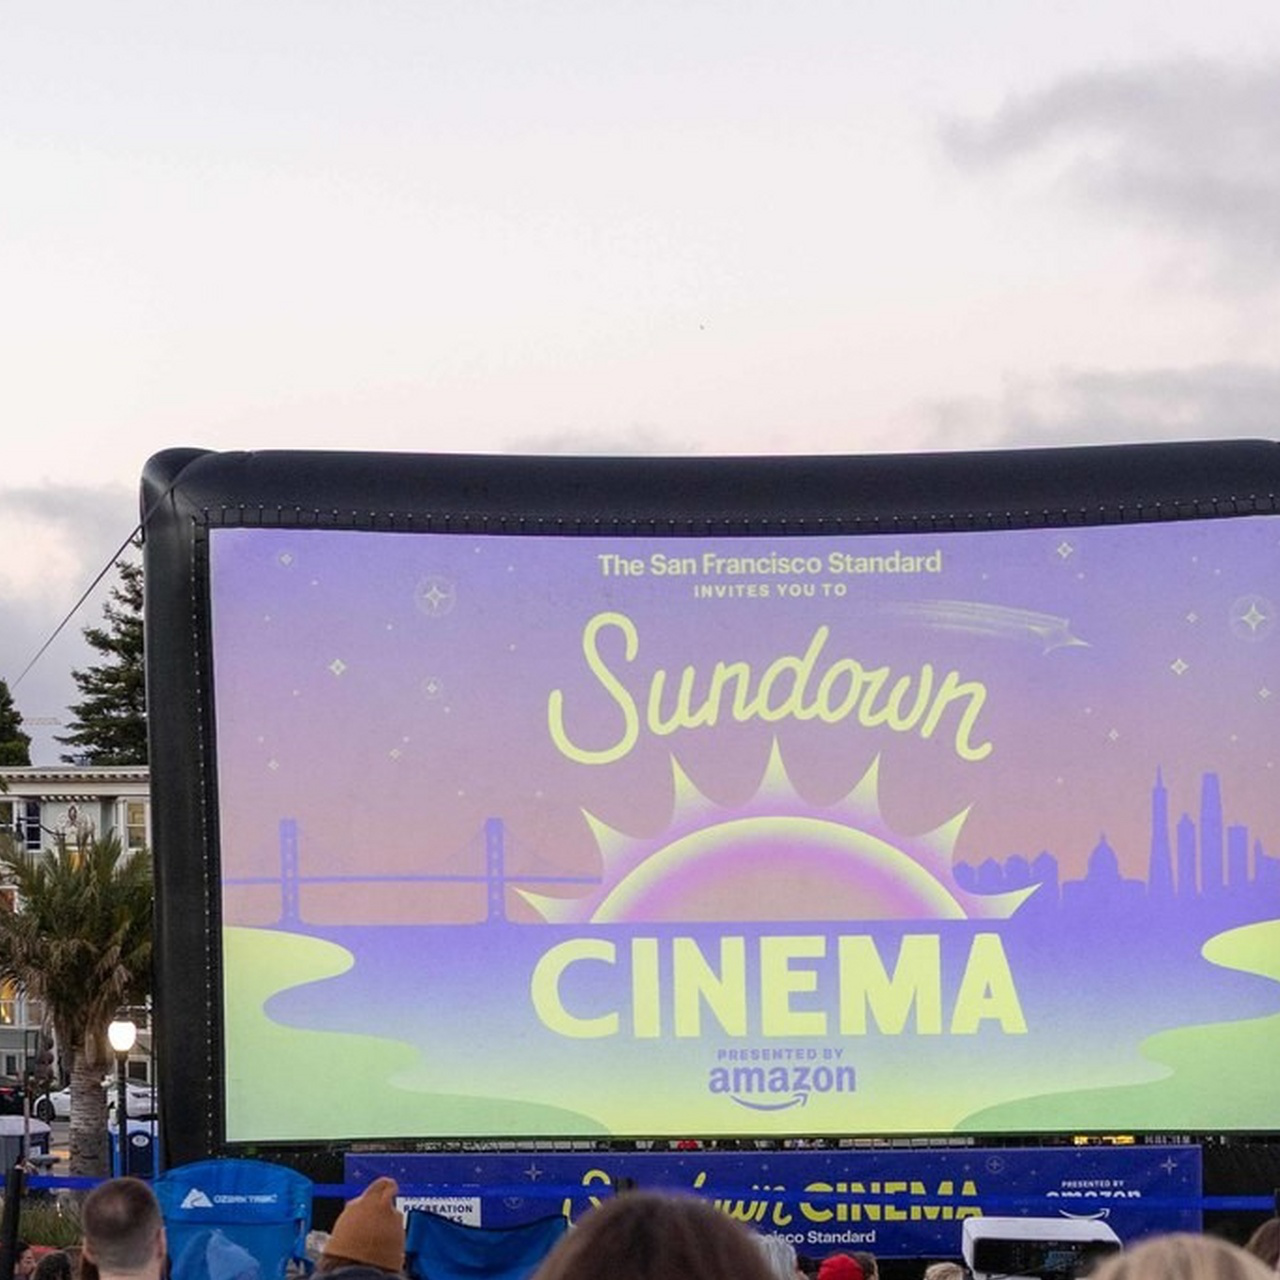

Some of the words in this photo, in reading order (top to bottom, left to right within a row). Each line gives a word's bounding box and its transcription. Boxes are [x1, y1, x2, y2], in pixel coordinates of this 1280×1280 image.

[597, 553, 645, 577] The
[650, 553, 697, 576] San
[702, 551, 822, 575] Francisco
[828, 549, 942, 574] Standard
[694, 584, 770, 599] INVITES
[776, 584, 816, 598] YOU
[822, 583, 848, 597] TO
[548, 612, 993, 765] Sundown
[531, 933, 1029, 1040] CINEMA
[717, 1048, 817, 1061] PRESENTED
[823, 1048, 844, 1060] BY
[708, 1065, 857, 1094] amazon
[1061, 1180, 1111, 1188] PRESENTED
[1113, 1180, 1124, 1188] BY
[799, 1181, 983, 1223] CINEMA
[807, 1229, 876, 1244] Standard
